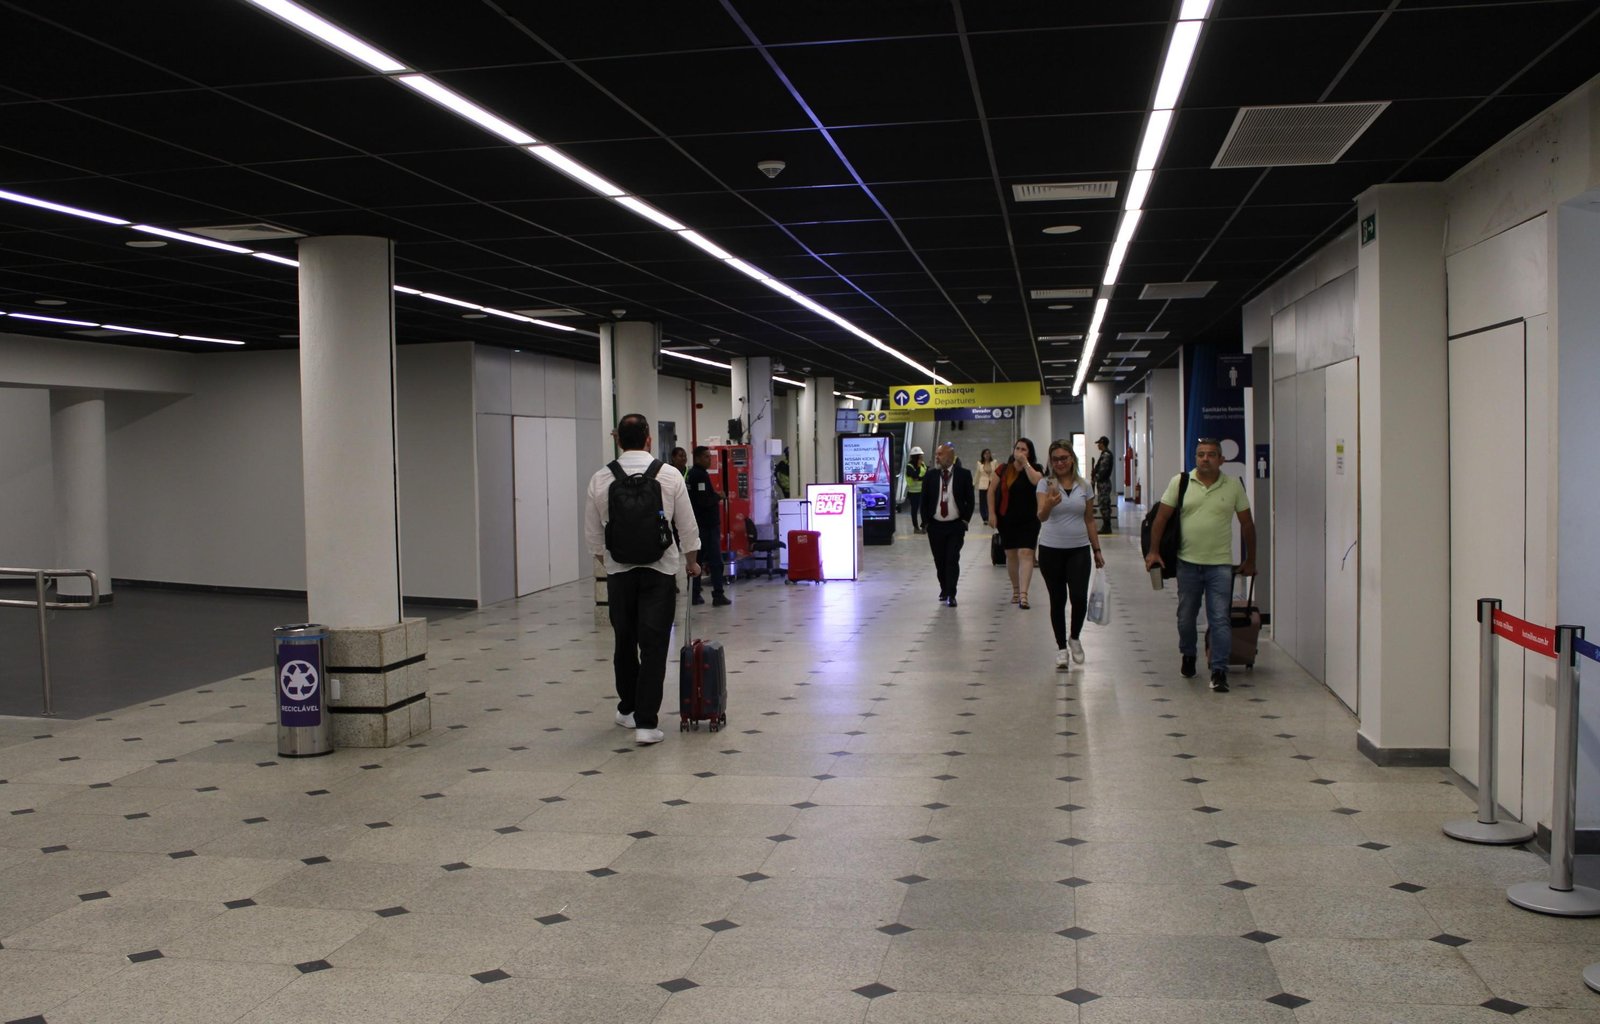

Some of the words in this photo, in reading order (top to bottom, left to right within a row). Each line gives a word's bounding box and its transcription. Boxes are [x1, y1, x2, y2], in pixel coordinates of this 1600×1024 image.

[934, 398, 976, 406] Departures
[817, 494, 845, 502] PROTEC
[815, 502, 844, 514] BAG
